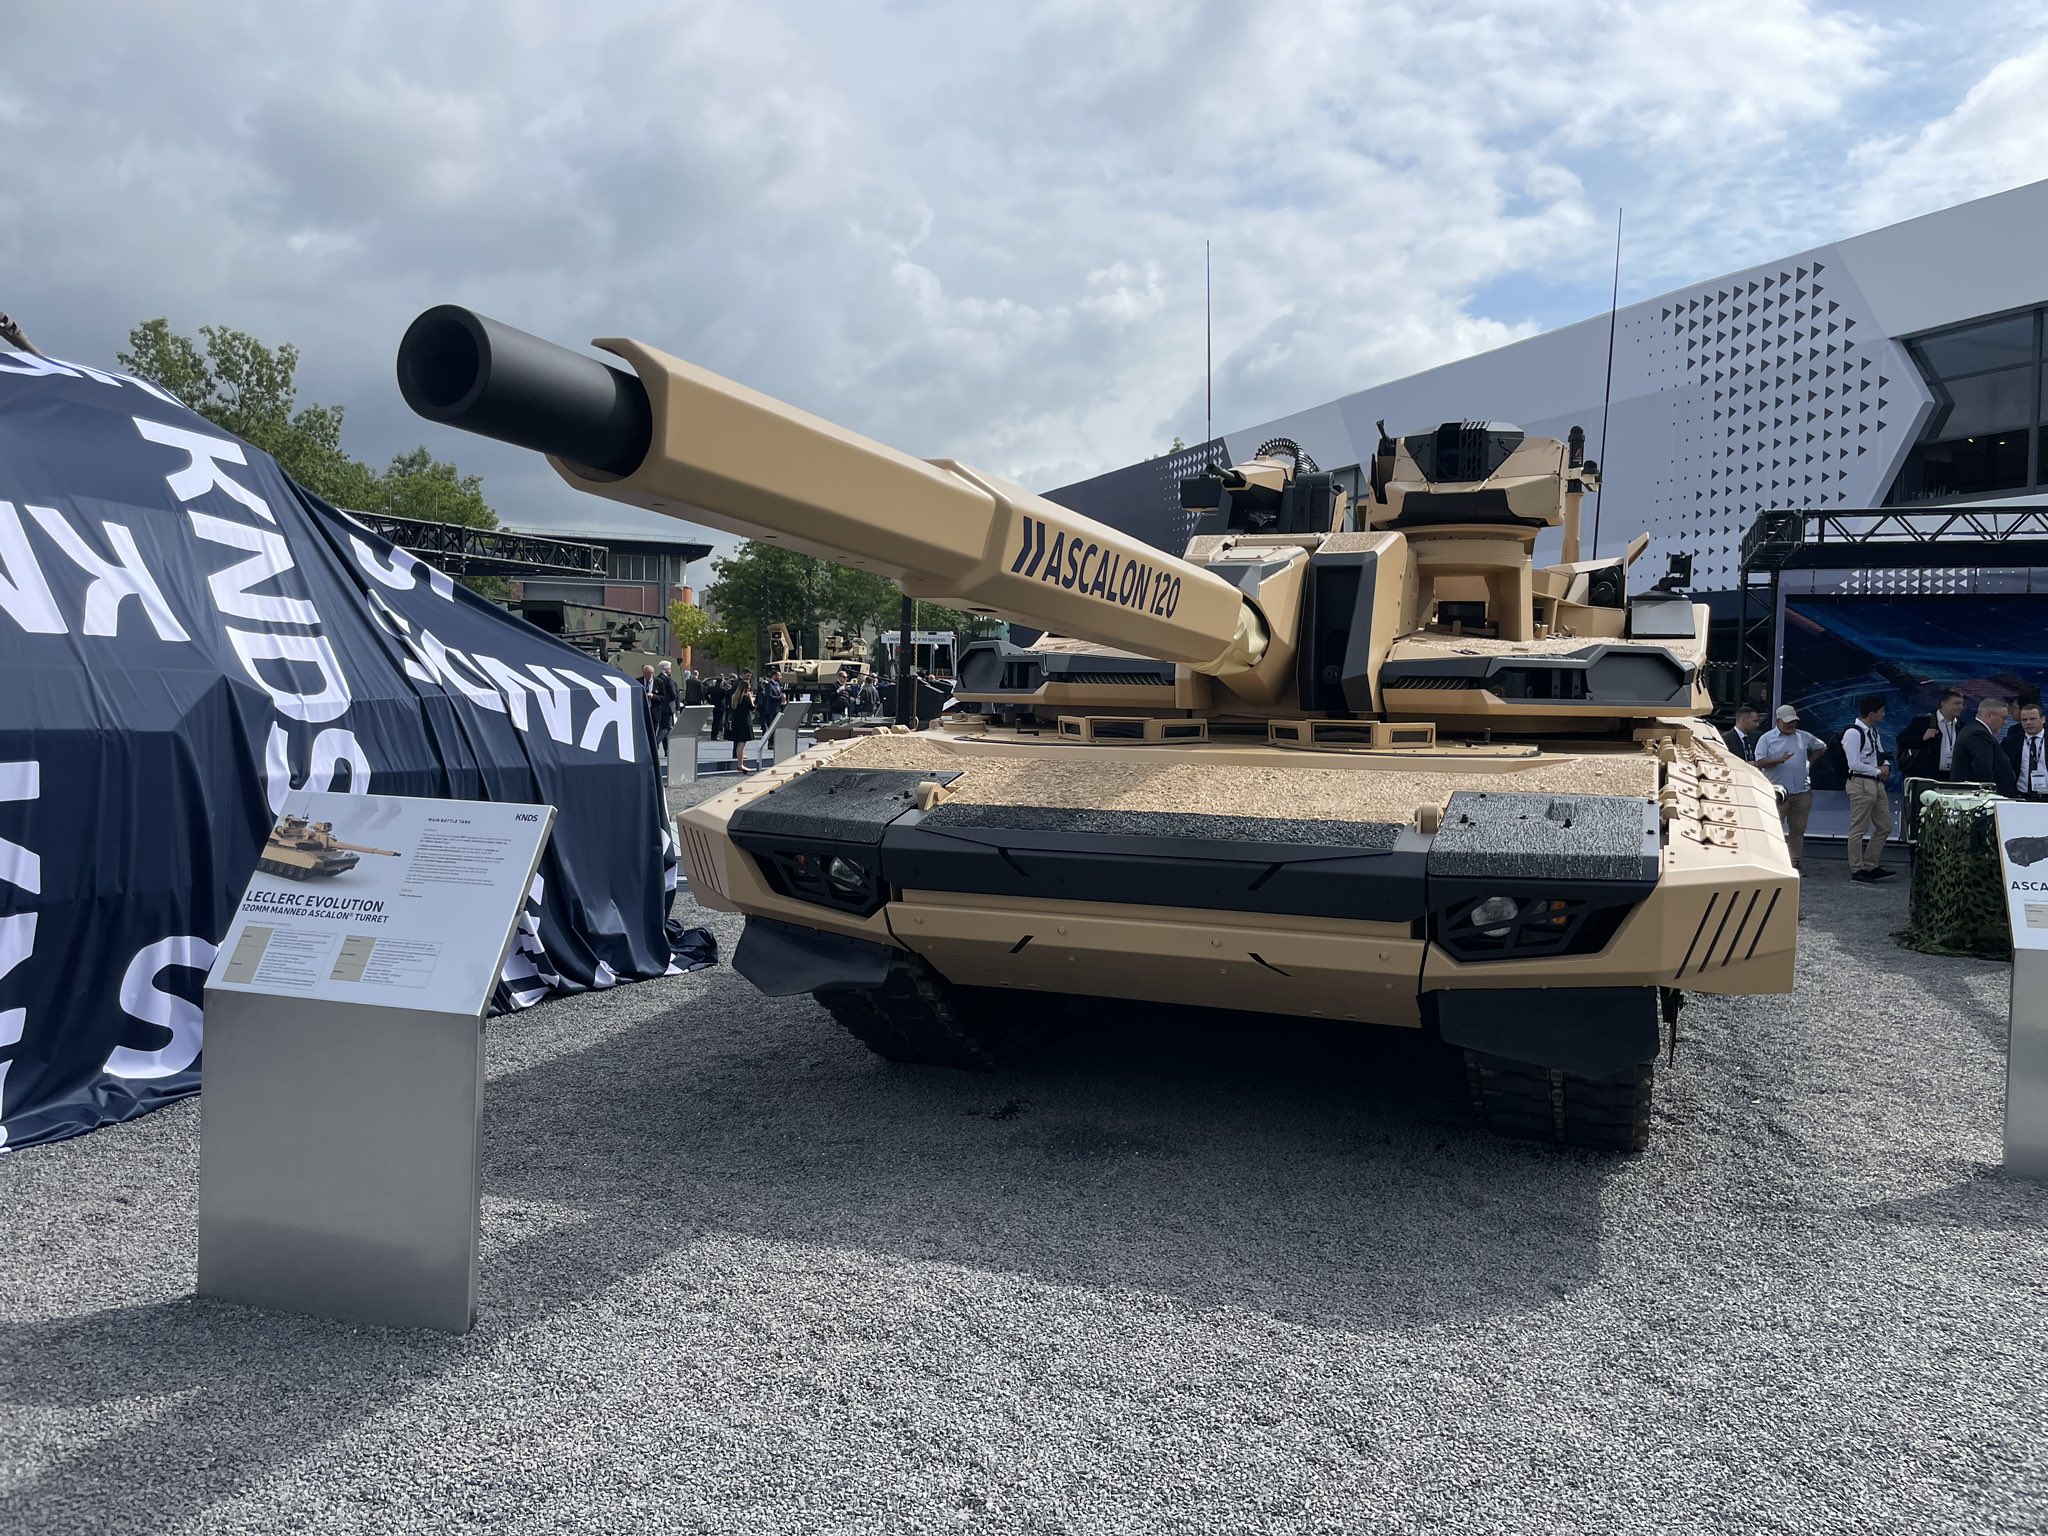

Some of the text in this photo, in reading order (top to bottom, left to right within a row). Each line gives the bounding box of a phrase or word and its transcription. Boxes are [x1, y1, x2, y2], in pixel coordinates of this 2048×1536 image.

[1042, 531, 1181, 619] ASCALON 120
[132, 416, 371, 816] KNDS
[515, 813, 539, 822] KNDS
[245, 890, 384, 912] LECLERC EVOLUTION
[241, 904, 270, 913] 120MM
[270, 906, 307, 917] MANNED
[355, 913, 389, 924] TURRET
